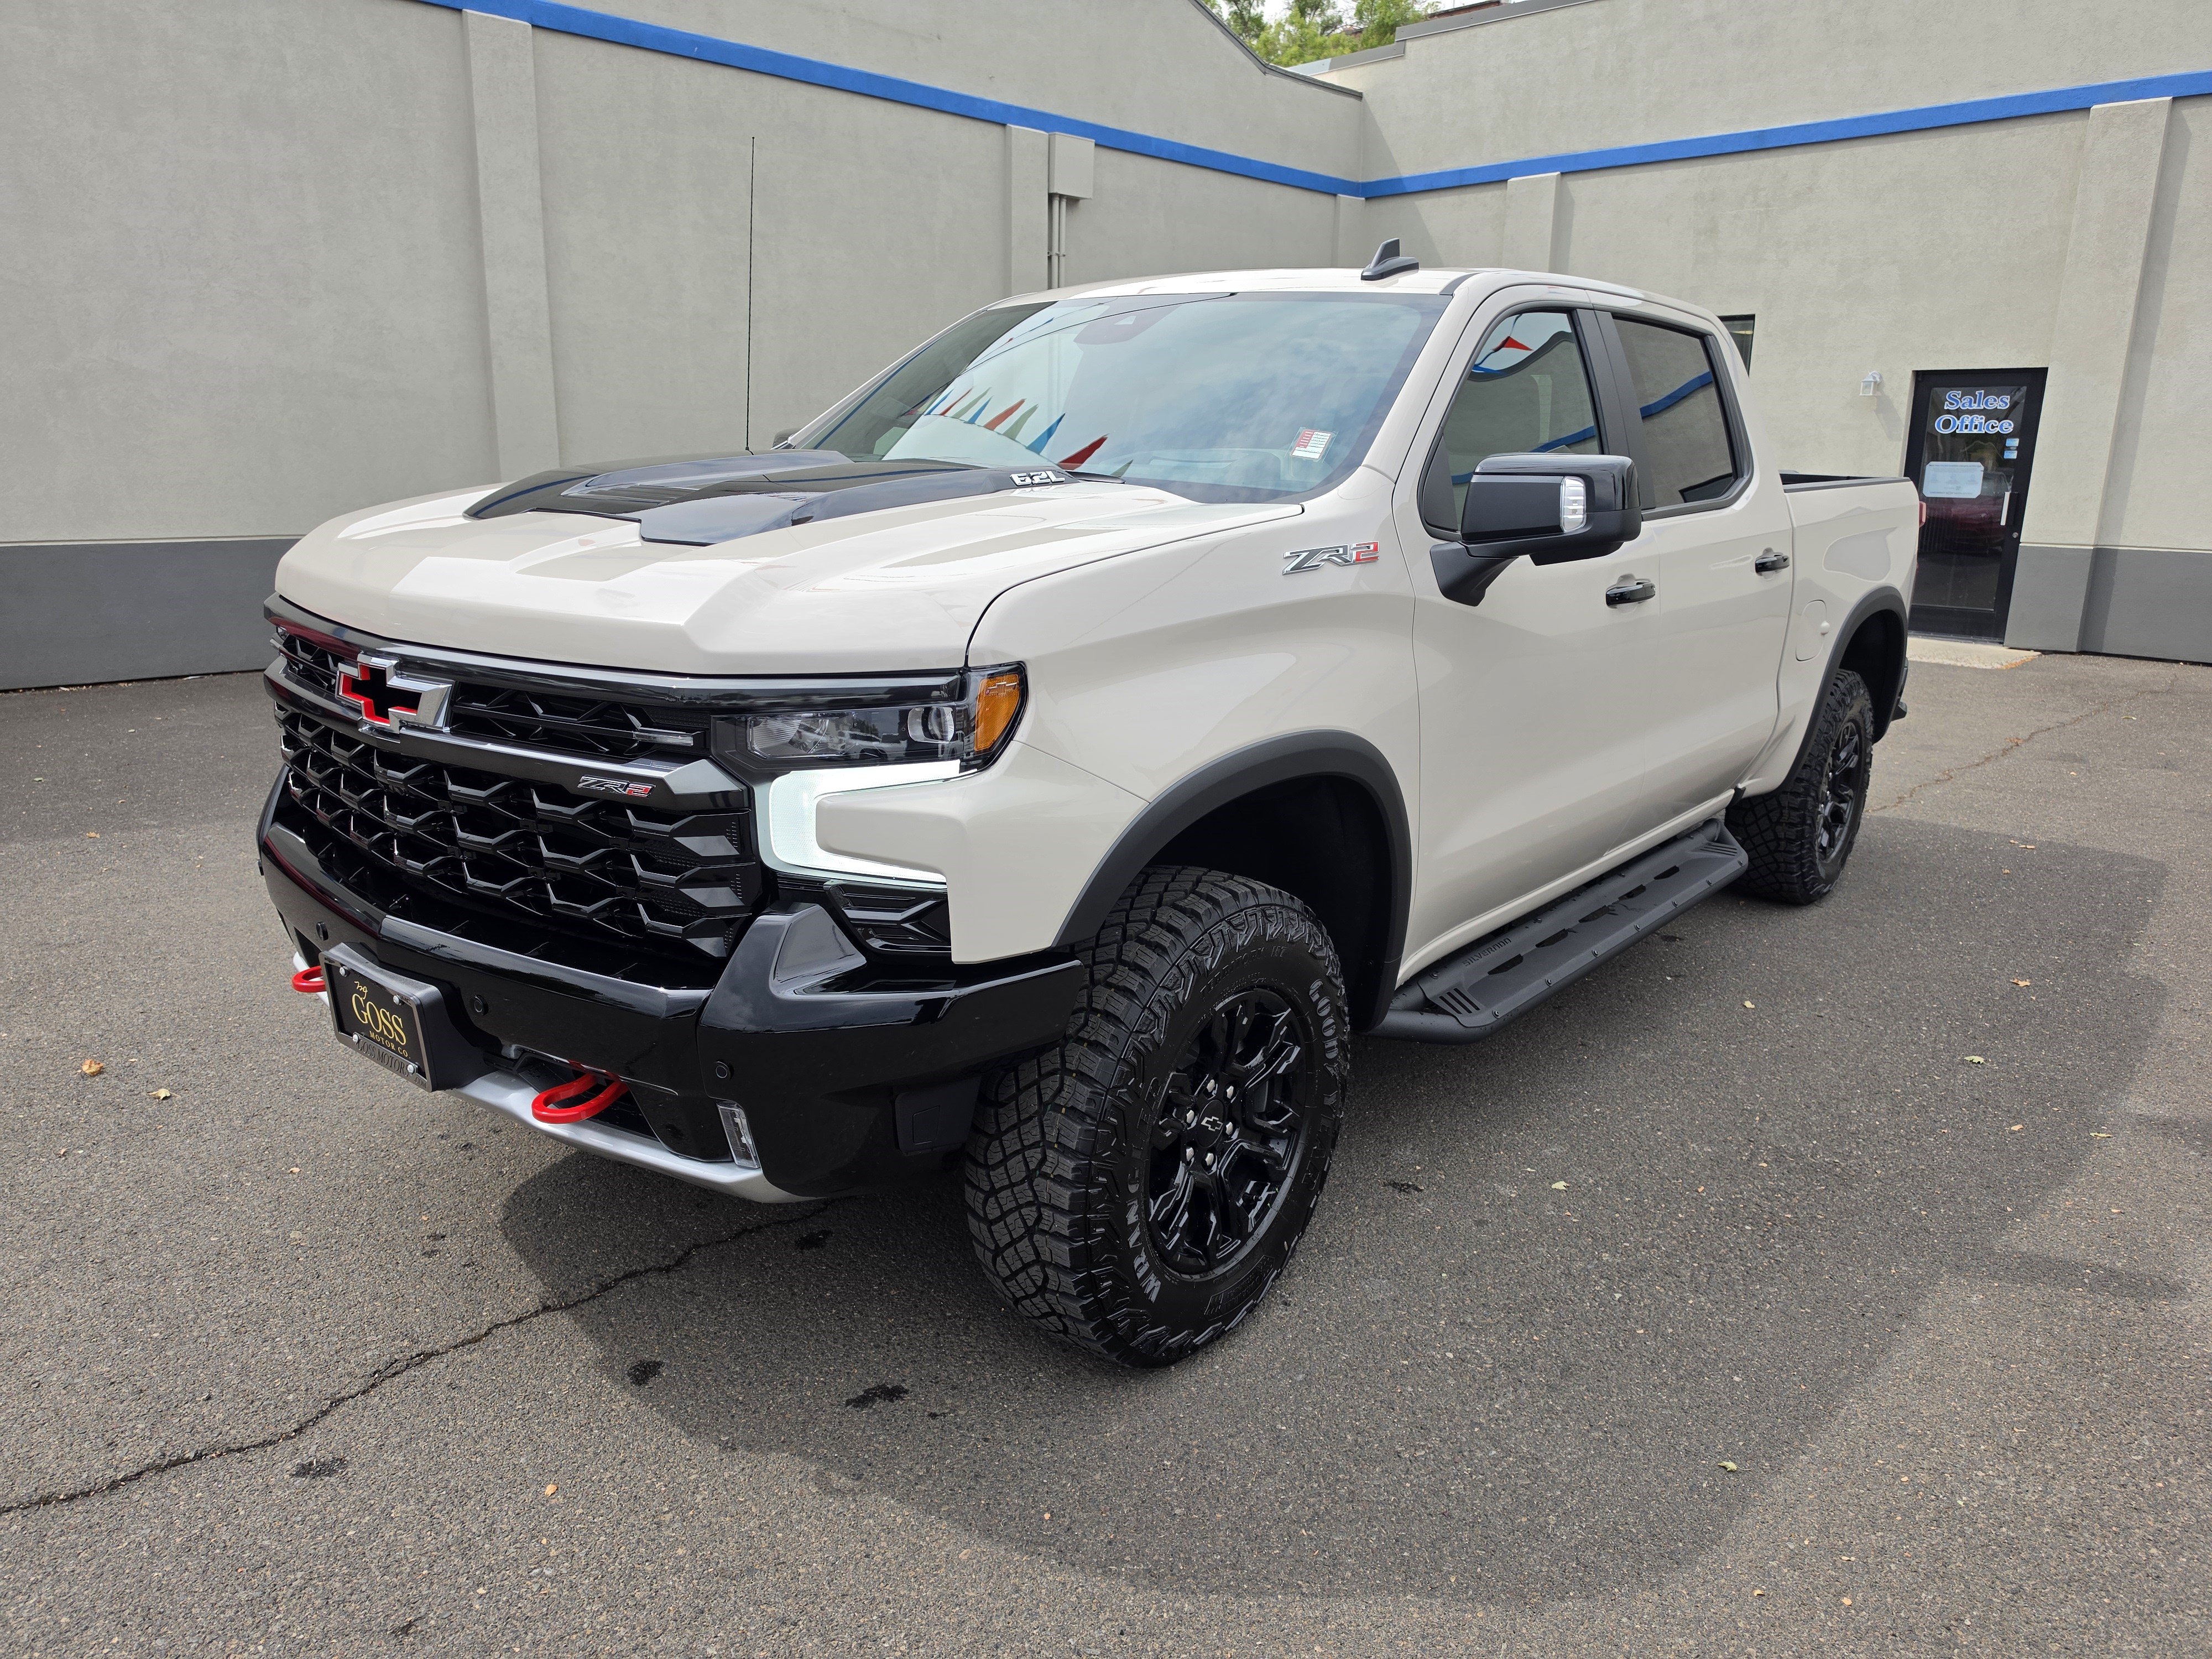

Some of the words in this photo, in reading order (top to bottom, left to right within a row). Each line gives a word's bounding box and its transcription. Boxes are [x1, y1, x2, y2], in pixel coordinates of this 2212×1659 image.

[1944, 390, 2010, 410] Sales
[1935, 414, 2014, 434] Office
[1282, 541, 1379, 575] ZR2
[577, 775, 656, 797] ZR2
[1462, 937, 1512, 967] SILVERADO
[352, 993, 406, 1045] GOSS
[369, 1030, 397, 1051] MOTOR
